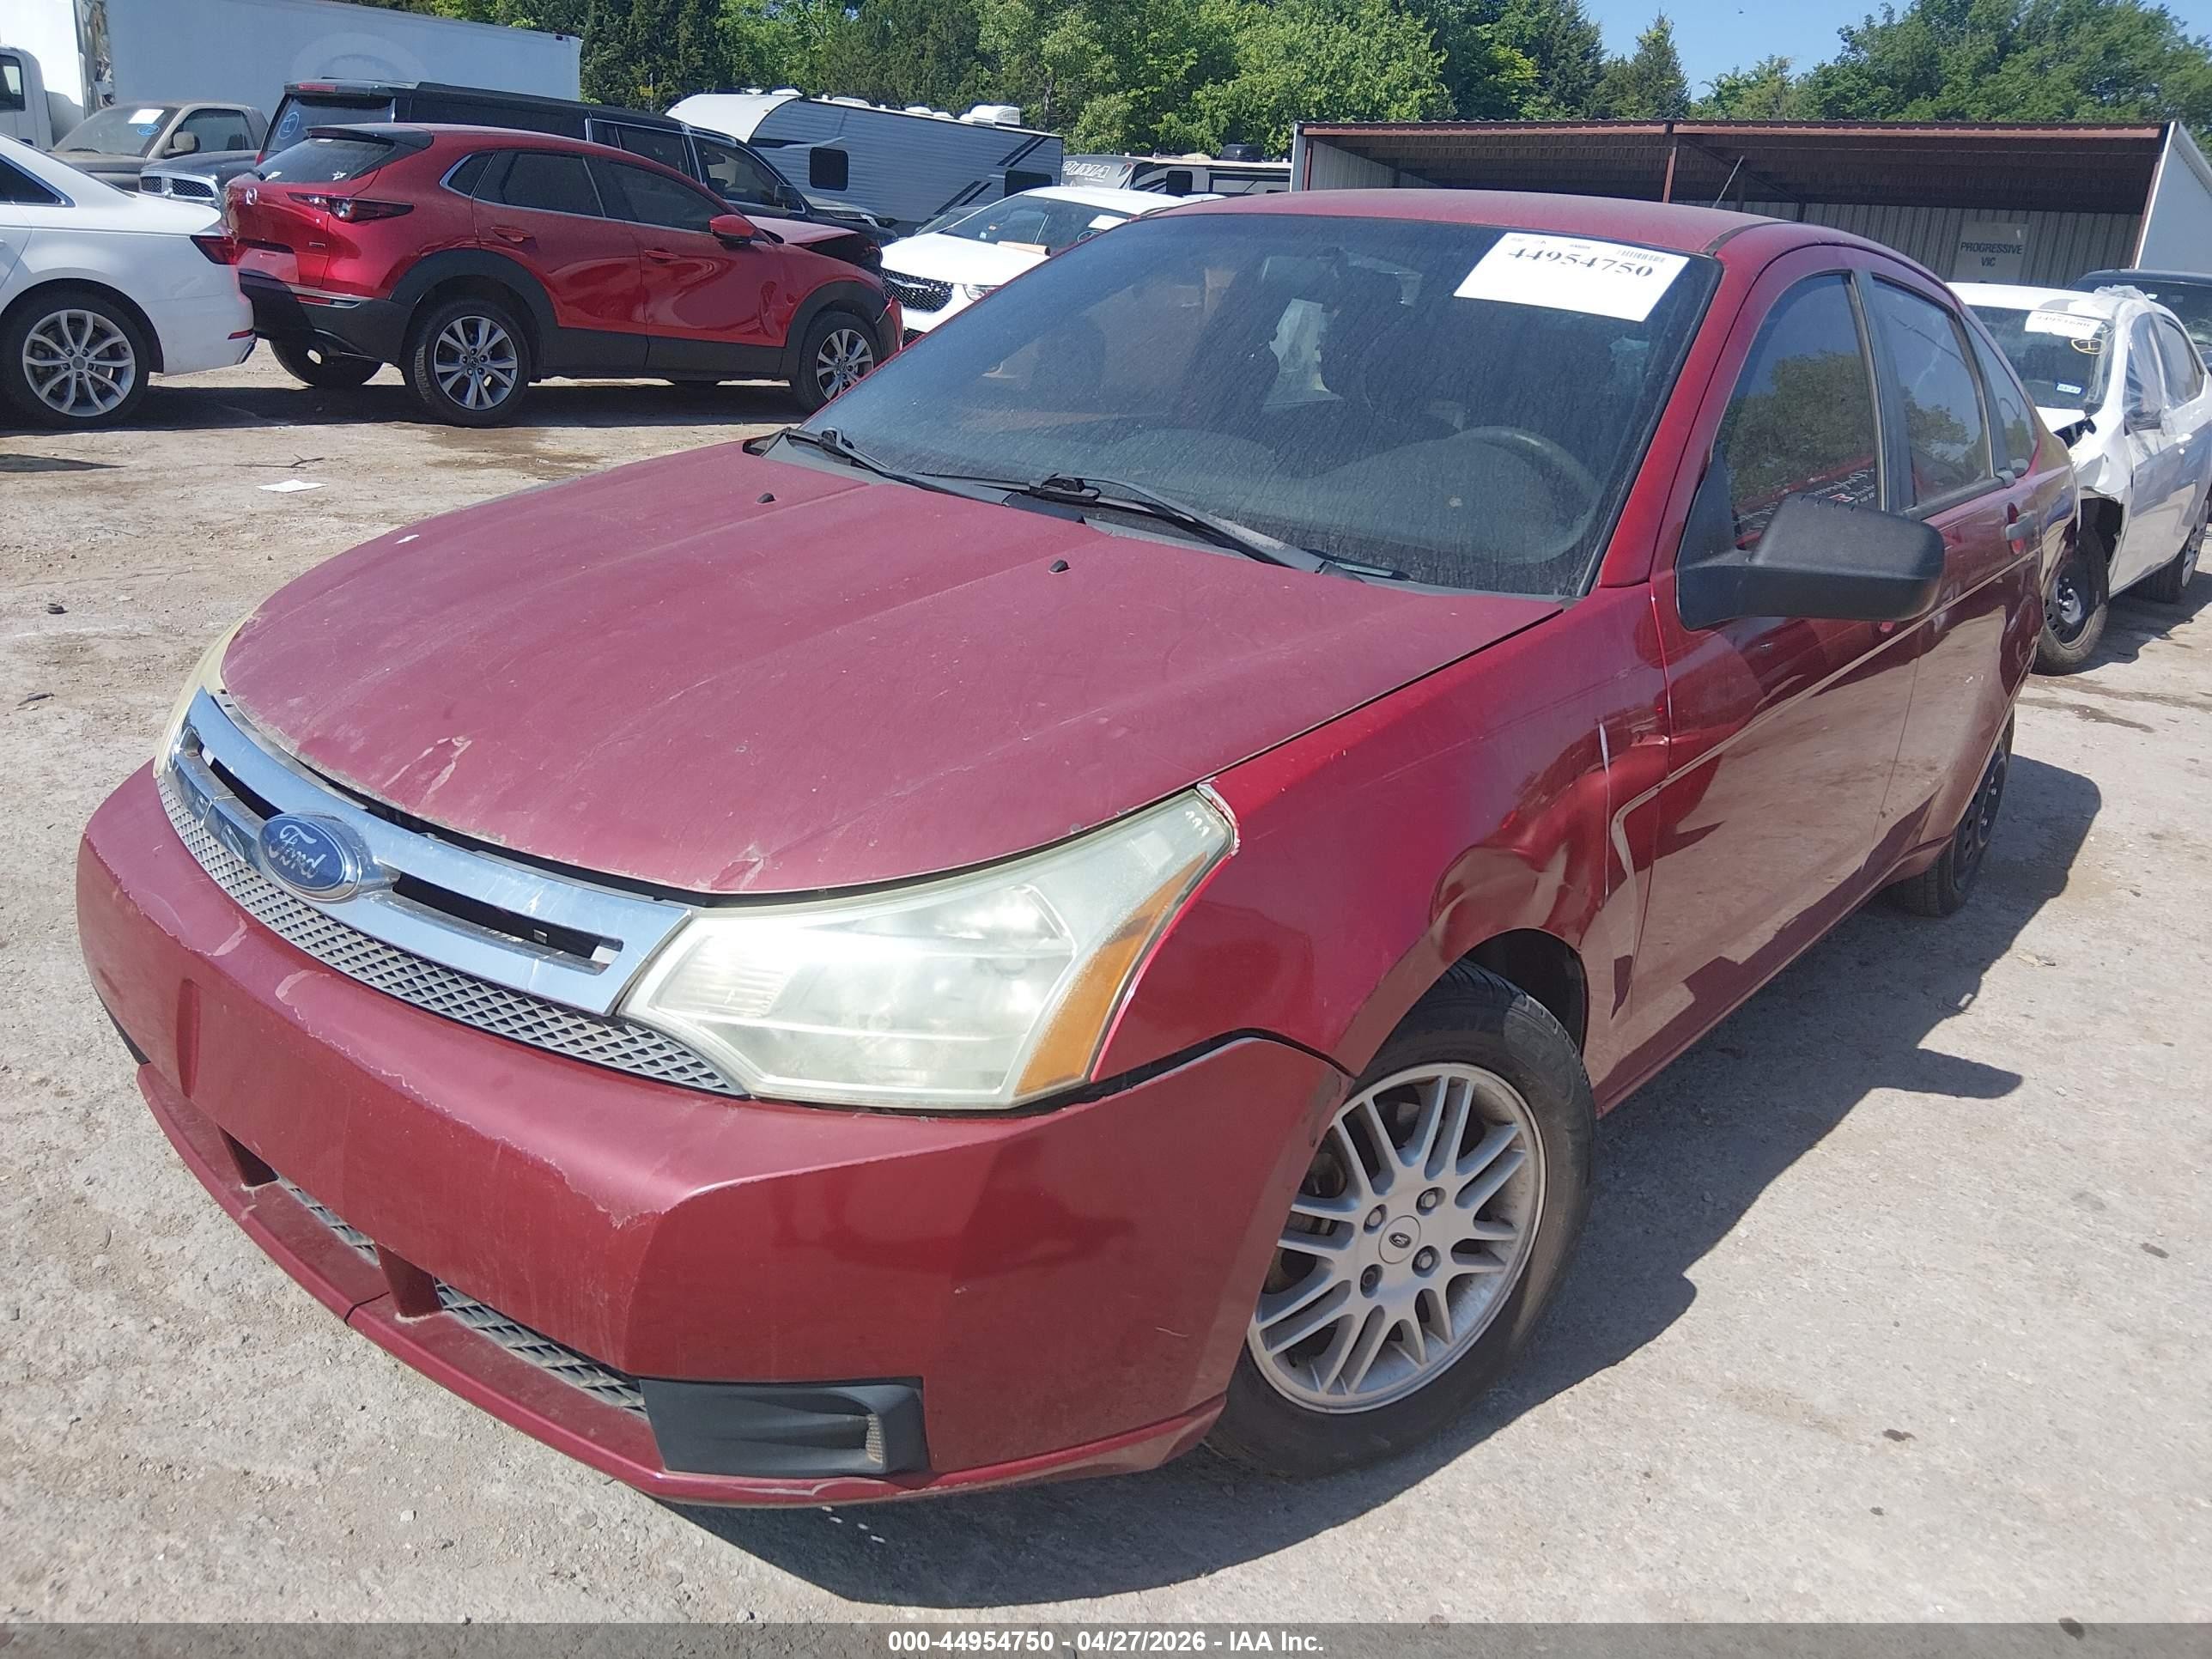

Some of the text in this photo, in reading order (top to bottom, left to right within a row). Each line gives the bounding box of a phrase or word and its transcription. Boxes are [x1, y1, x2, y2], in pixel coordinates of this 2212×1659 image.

[1960, 241, 2023, 255] PROGRESSIVE
[1507, 247, 1654, 277] 44954750
[1981, 256, 1996, 267] VIC
[268, 824, 327, 879] Ford
